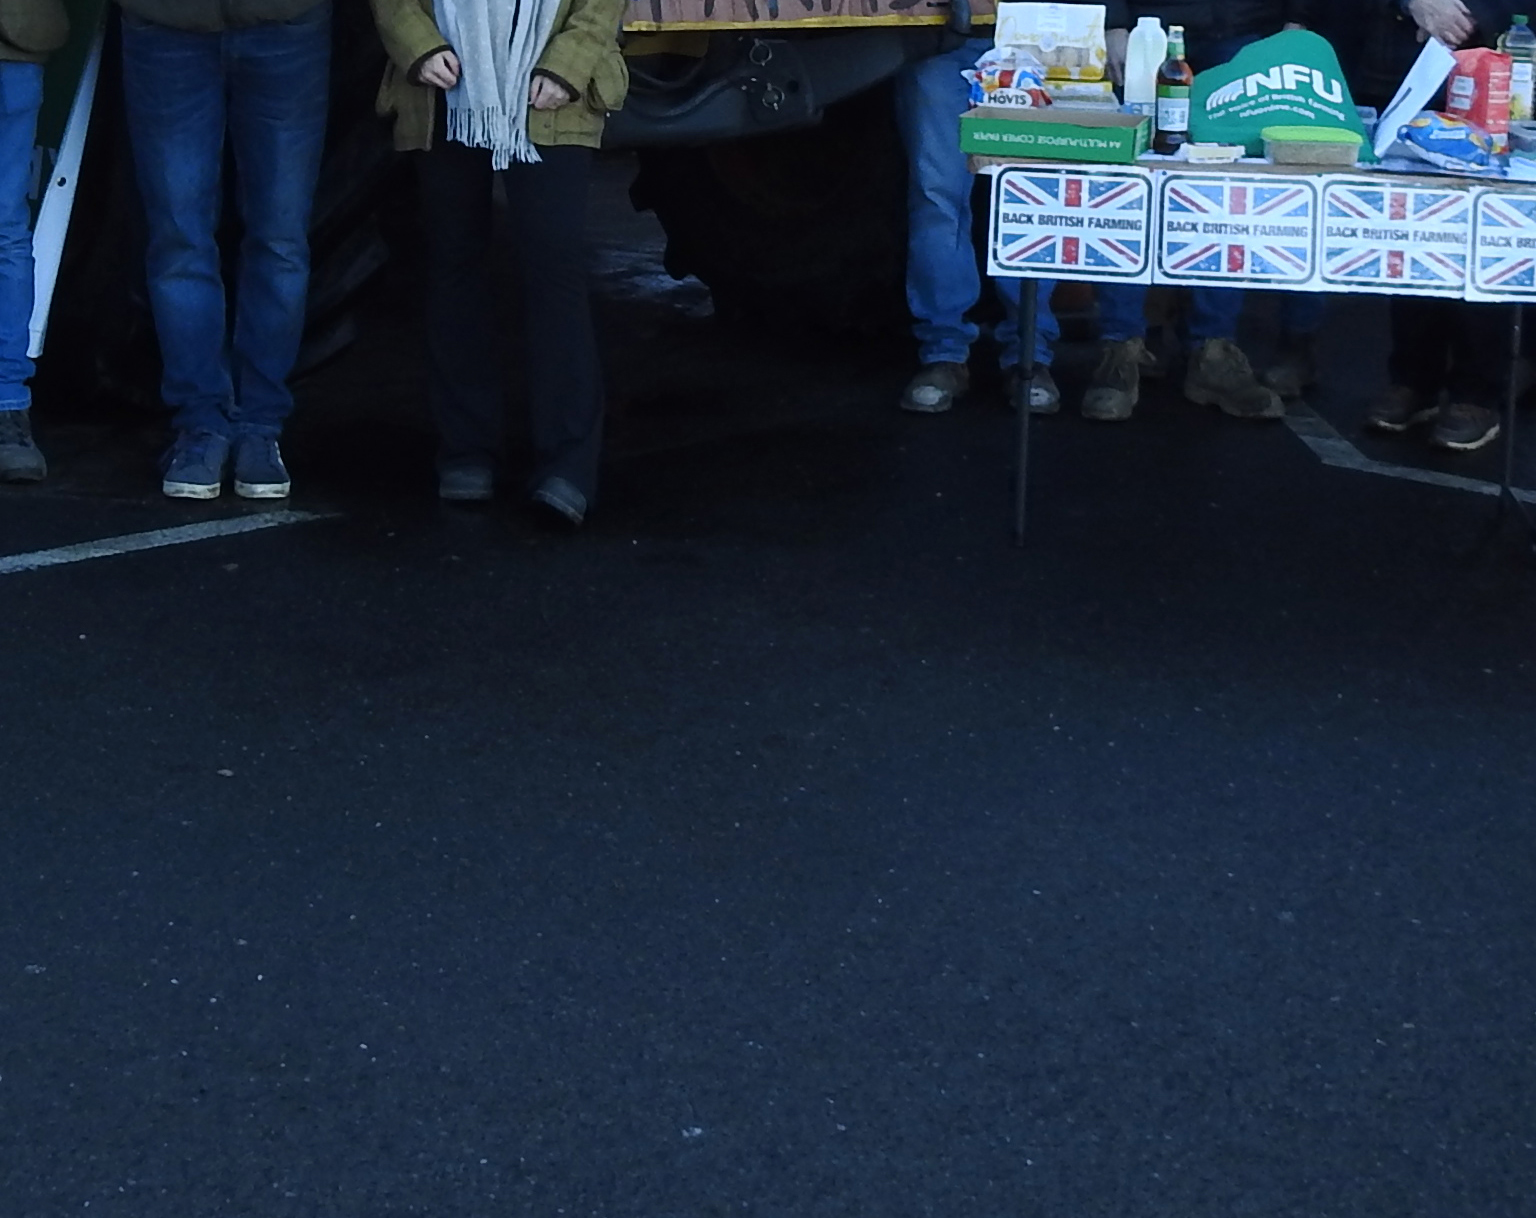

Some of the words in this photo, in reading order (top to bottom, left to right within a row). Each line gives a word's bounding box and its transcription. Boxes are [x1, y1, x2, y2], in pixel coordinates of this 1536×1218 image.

[1244, 63, 1344, 104] NFU
[1001, 211, 1034, 226] BACK
[1037, 213, 1085, 229] BRITISH
[1087, 215, 1143, 232] FARMING
[1166, 220, 1199, 234] BACK
[1202, 221, 1250, 236] BRITISH
[1252, 224, 1309, 239] FARMING
[1325, 225, 1358, 240] BACK
[1361, 227, 1410, 242] BRITISH
[1412, 230, 1467, 246] FARMING
[1479, 235, 1513, 249] BACK
